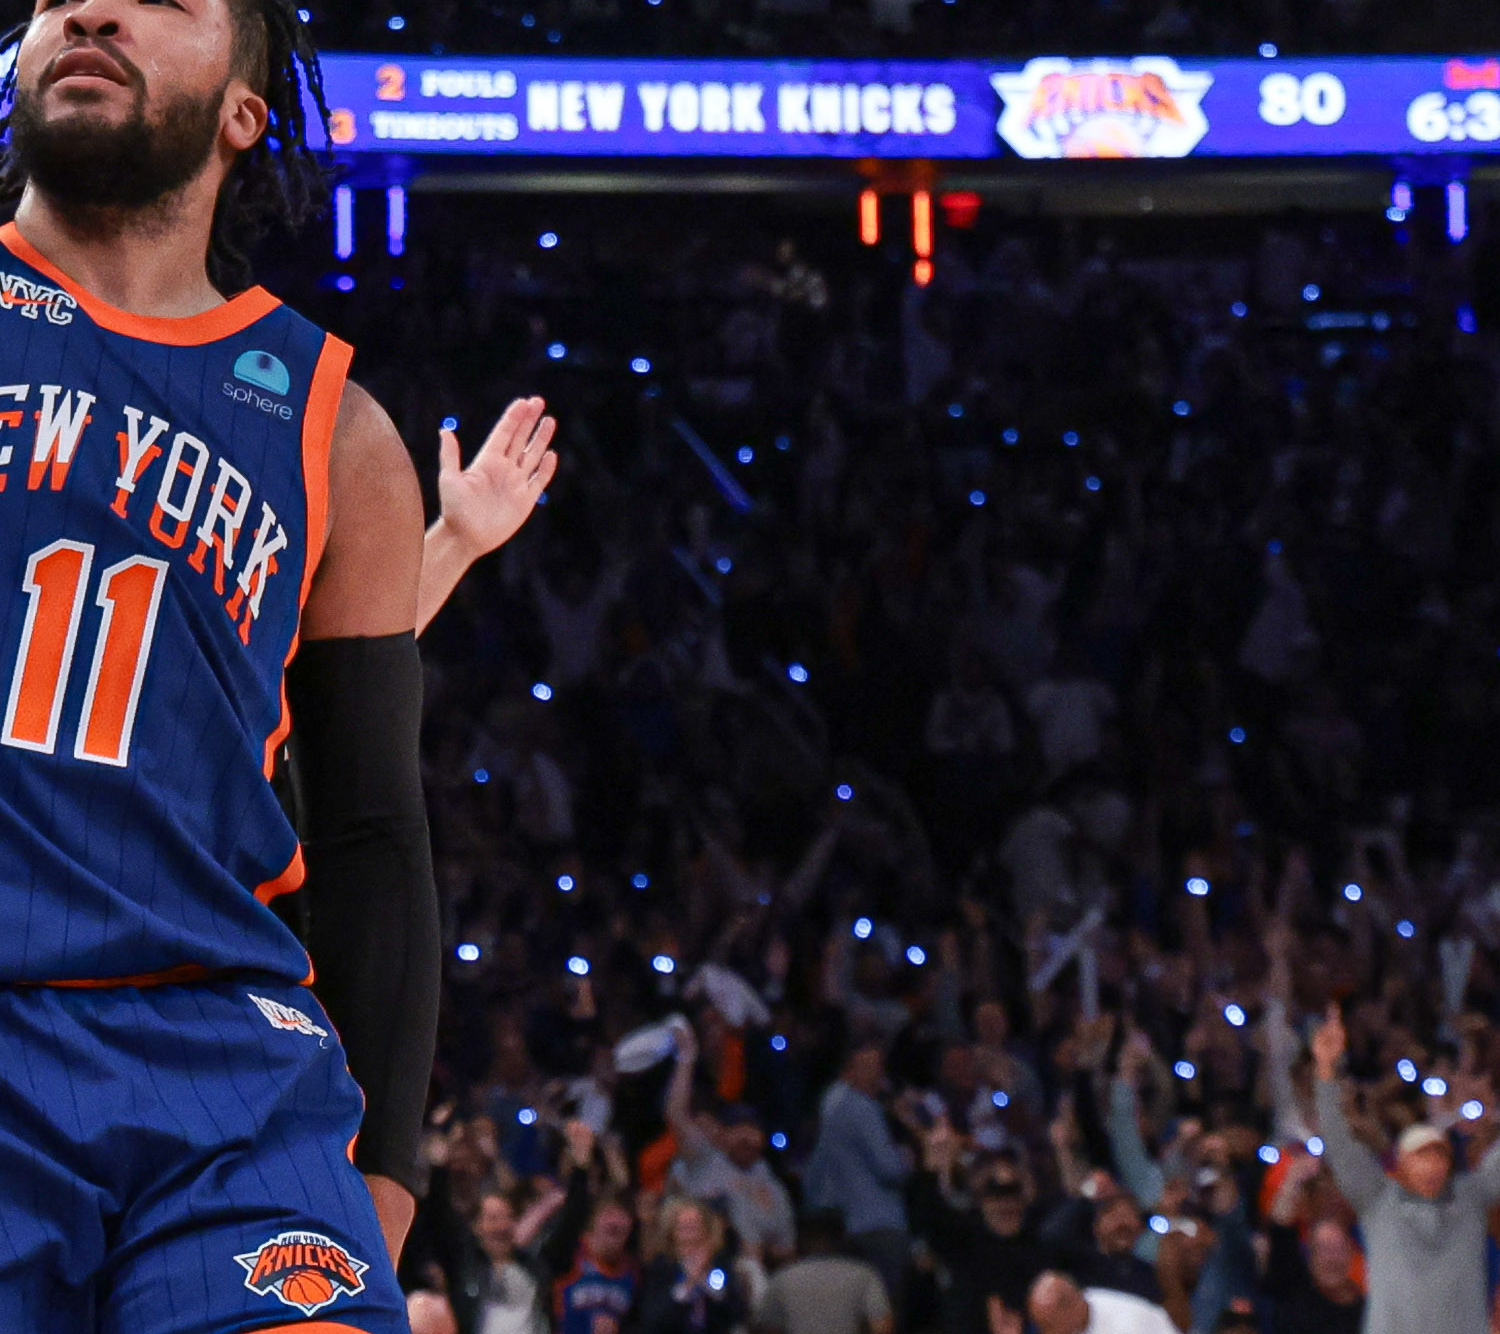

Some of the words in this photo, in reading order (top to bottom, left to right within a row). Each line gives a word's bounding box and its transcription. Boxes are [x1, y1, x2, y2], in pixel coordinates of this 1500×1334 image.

[376, 65, 406, 101] 2
[420, 69, 518, 99] FOULS
[526, 80, 625, 133] NEW
[637, 81, 765, 134] YORK
[777, 81, 956, 135] KNICKS
[1259, 72, 1347, 126] 80
[222, 381, 294, 421] sphere
[112, 404, 288, 635] YORK
[0, 538, 170, 767] 11
[250, 1243, 361, 1288] KNICKS
